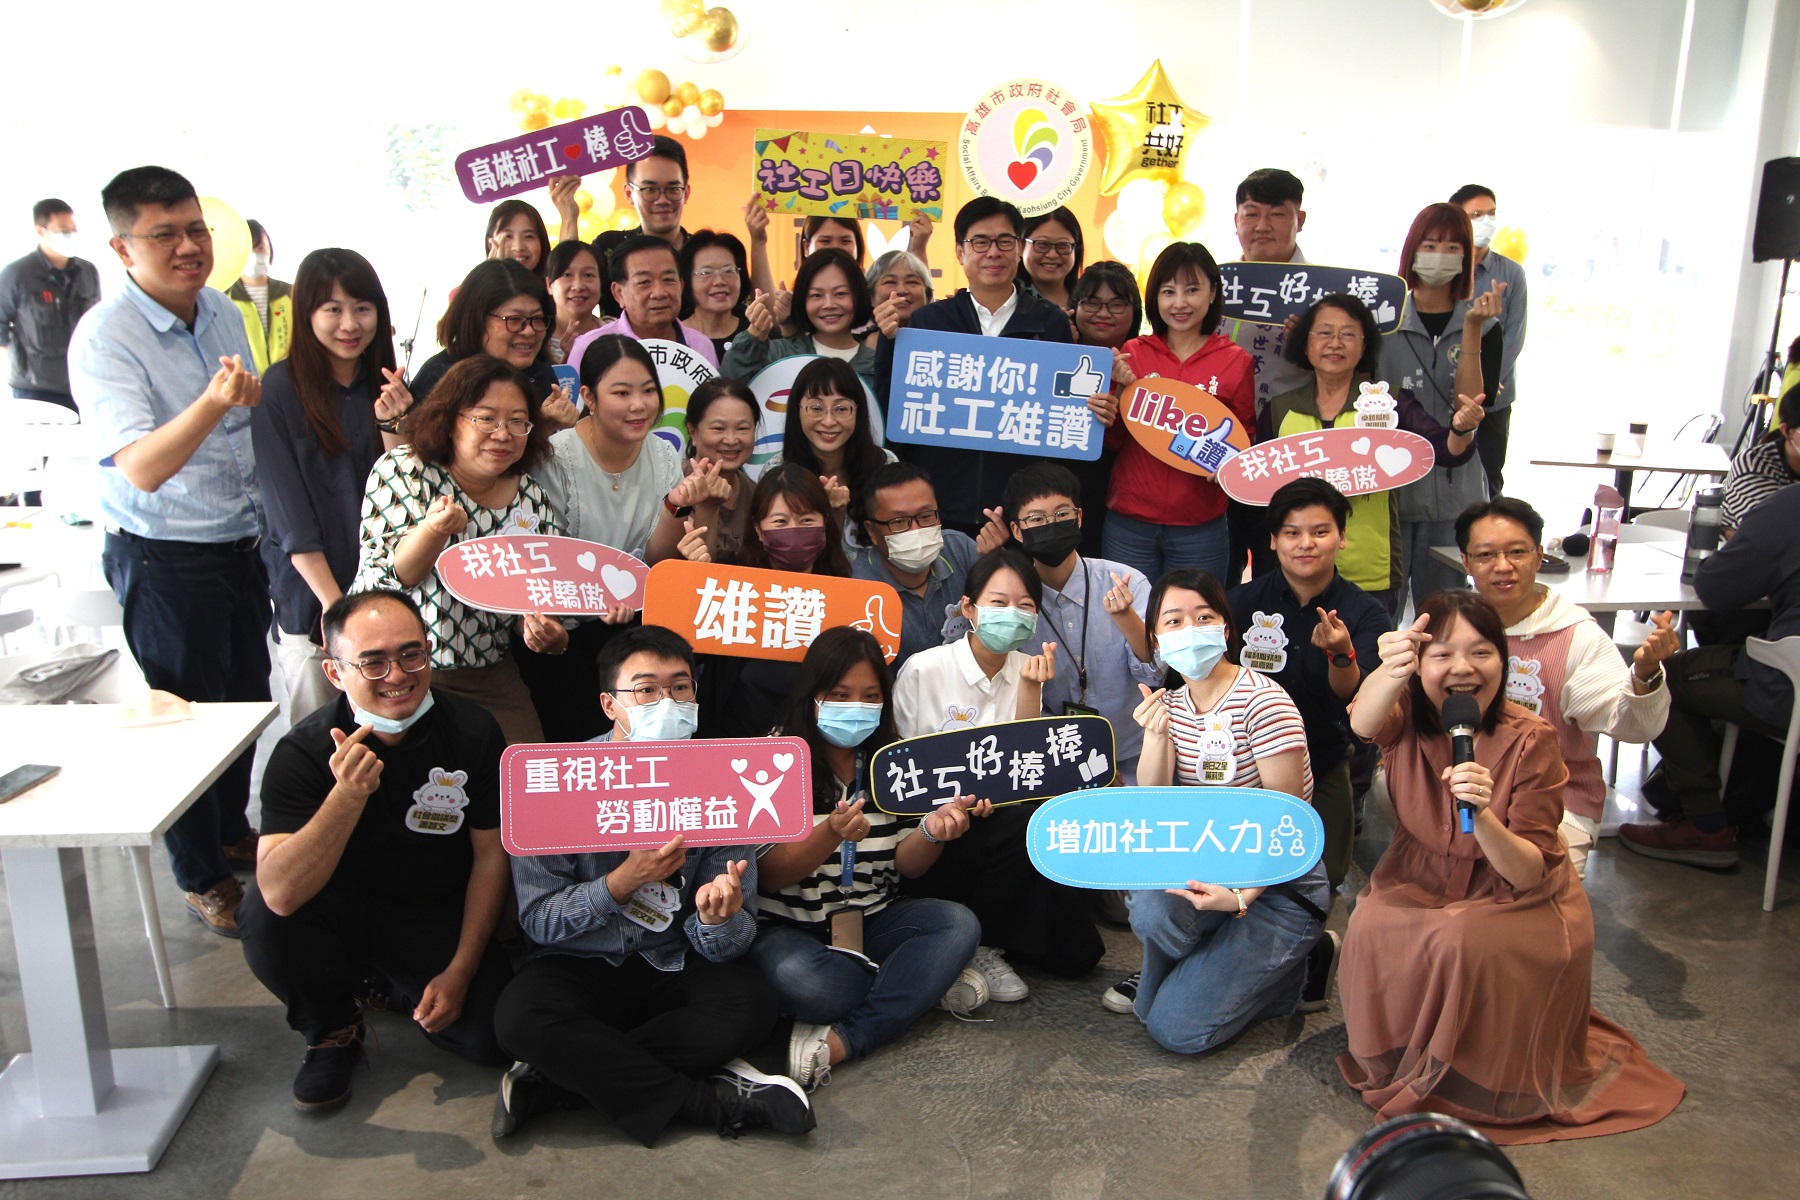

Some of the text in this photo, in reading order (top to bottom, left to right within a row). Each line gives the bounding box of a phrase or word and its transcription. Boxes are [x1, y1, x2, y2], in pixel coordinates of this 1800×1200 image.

[964, 82, 1088, 136] 高雄市政府社會局
[467, 124, 611, 197] 高雄社工 棒
[962, 138, 971, 164] Social
[1069, 138, 1089, 187] Government
[757, 158, 944, 204] 社工日快樂
[965, 165, 982, 191] Affairs
[1057, 187, 1073, 201] City
[1219, 271, 1380, 318] 社工好棒
[903, 349, 1039, 396] 感謝你!
[899, 391, 1094, 452] 社工雄讚
[1126, 386, 1209, 441] like
[1195, 438, 1229, 470] 讚
[1238, 436, 1330, 482] 我社工
[459, 541, 558, 580] 我社工
[526, 576, 607, 611] 我驕傲
[693, 577, 827, 650] 雄讚
[524, 756, 671, 795] 重視社工
[886, 723, 1084, 806] 社工好棒棒
[1202, 761, 1228, 771] 明日之星
[596, 795, 739, 836] 勞動權益
[1045, 818, 1264, 855] 增加社工人力
